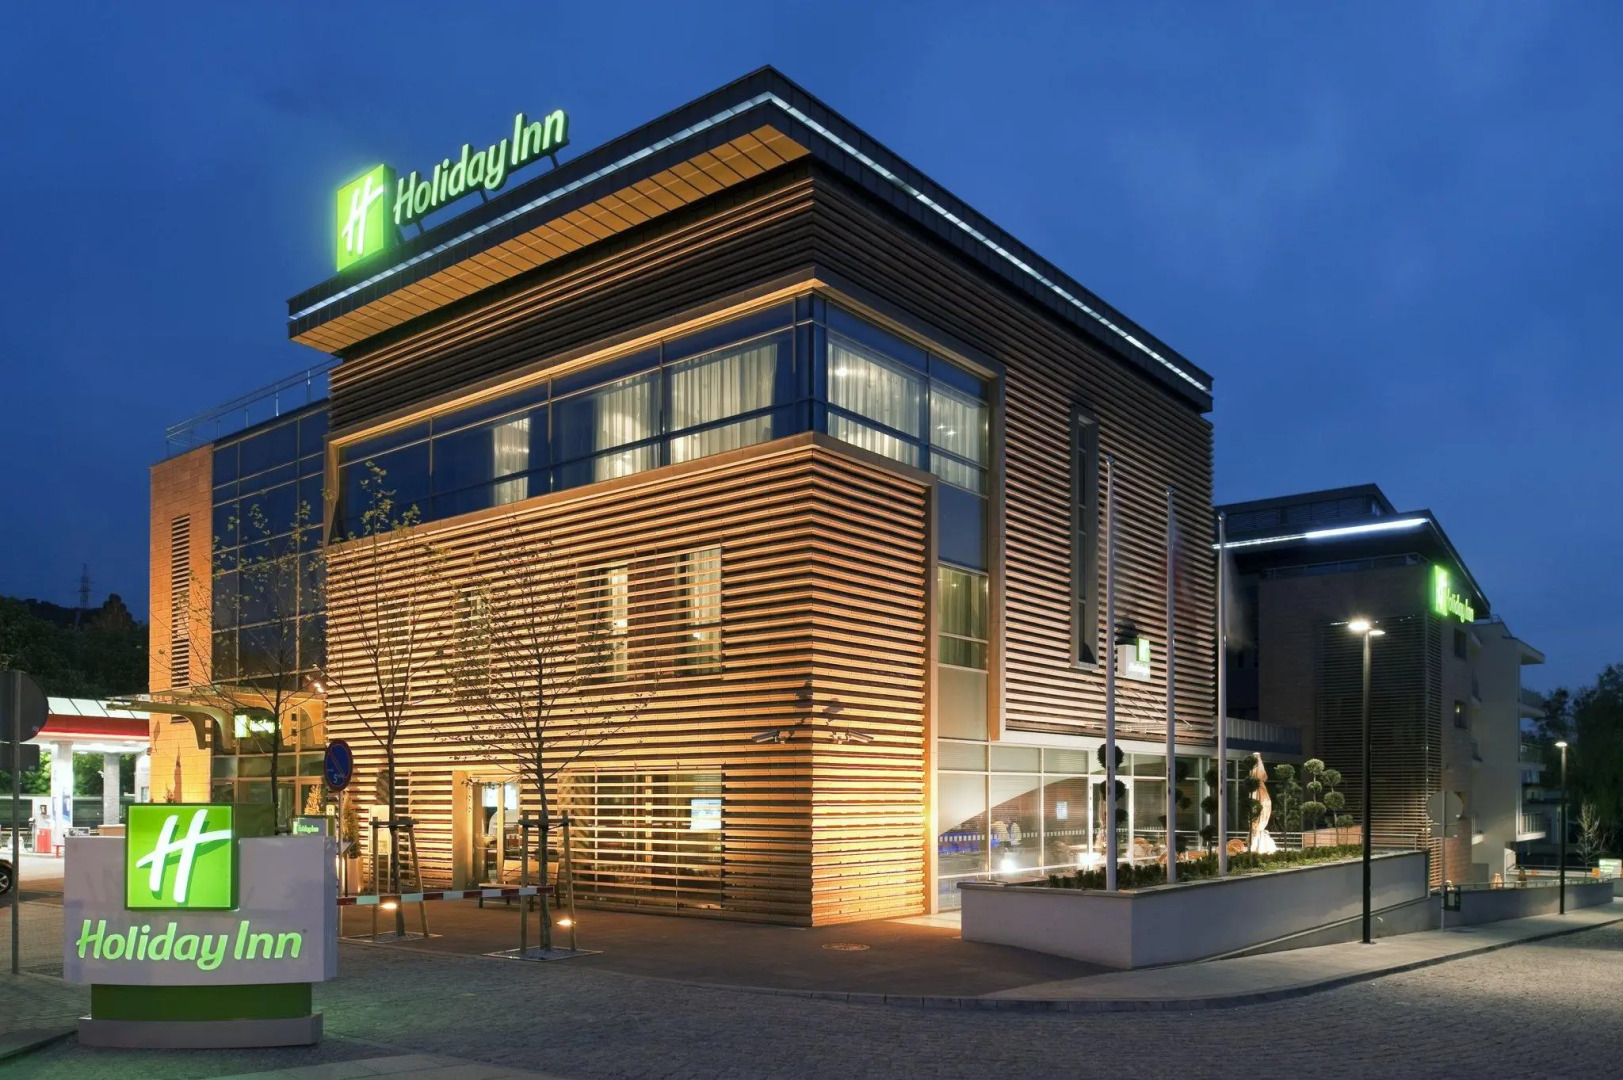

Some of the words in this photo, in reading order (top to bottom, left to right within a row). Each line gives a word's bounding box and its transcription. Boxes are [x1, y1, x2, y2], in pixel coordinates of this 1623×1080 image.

[393, 138, 507, 225] Holiday
[511, 109, 565, 166] Inn
[136, 808, 232, 903] H
[76, 919, 228, 970] Holiday
[234, 920, 302, 960] Inn
